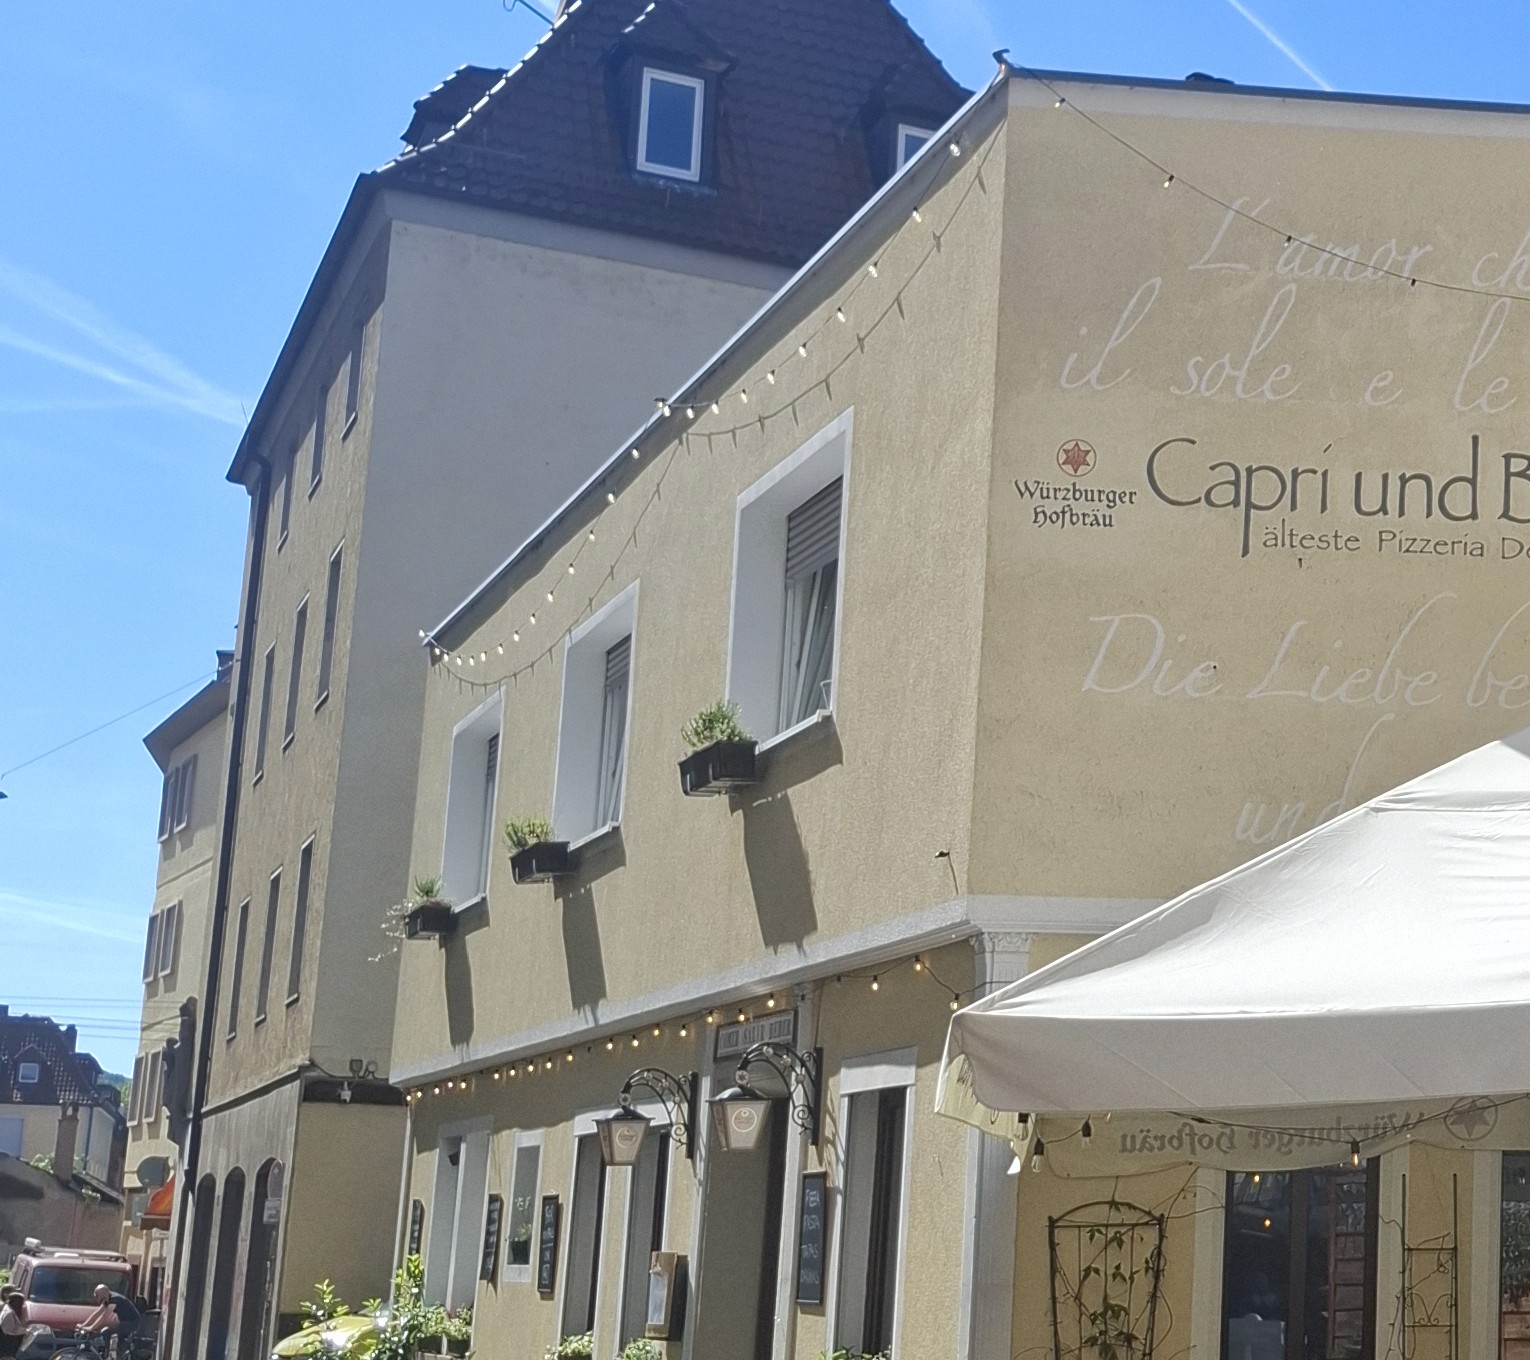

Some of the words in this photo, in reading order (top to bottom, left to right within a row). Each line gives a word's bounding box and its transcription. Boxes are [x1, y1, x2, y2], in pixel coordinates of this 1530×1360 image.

[1059, 276, 1162, 391] il
[1169, 283, 1303, 401] sole
[1364, 368, 1402, 407] e
[1453, 297, 1517, 414] le
[1014, 478, 1137, 509] Würzburger
[1032, 504, 1115, 528] Hofbräu
[1146, 437, 1333, 558] Capri
[1354, 434, 1480, 523] und
[1262, 518, 1361, 552] älteste
[1378, 529, 1486, 559] Pizzeria
[1081, 612, 1224, 699] Die
[1246, 591, 1458, 707] Liebe
